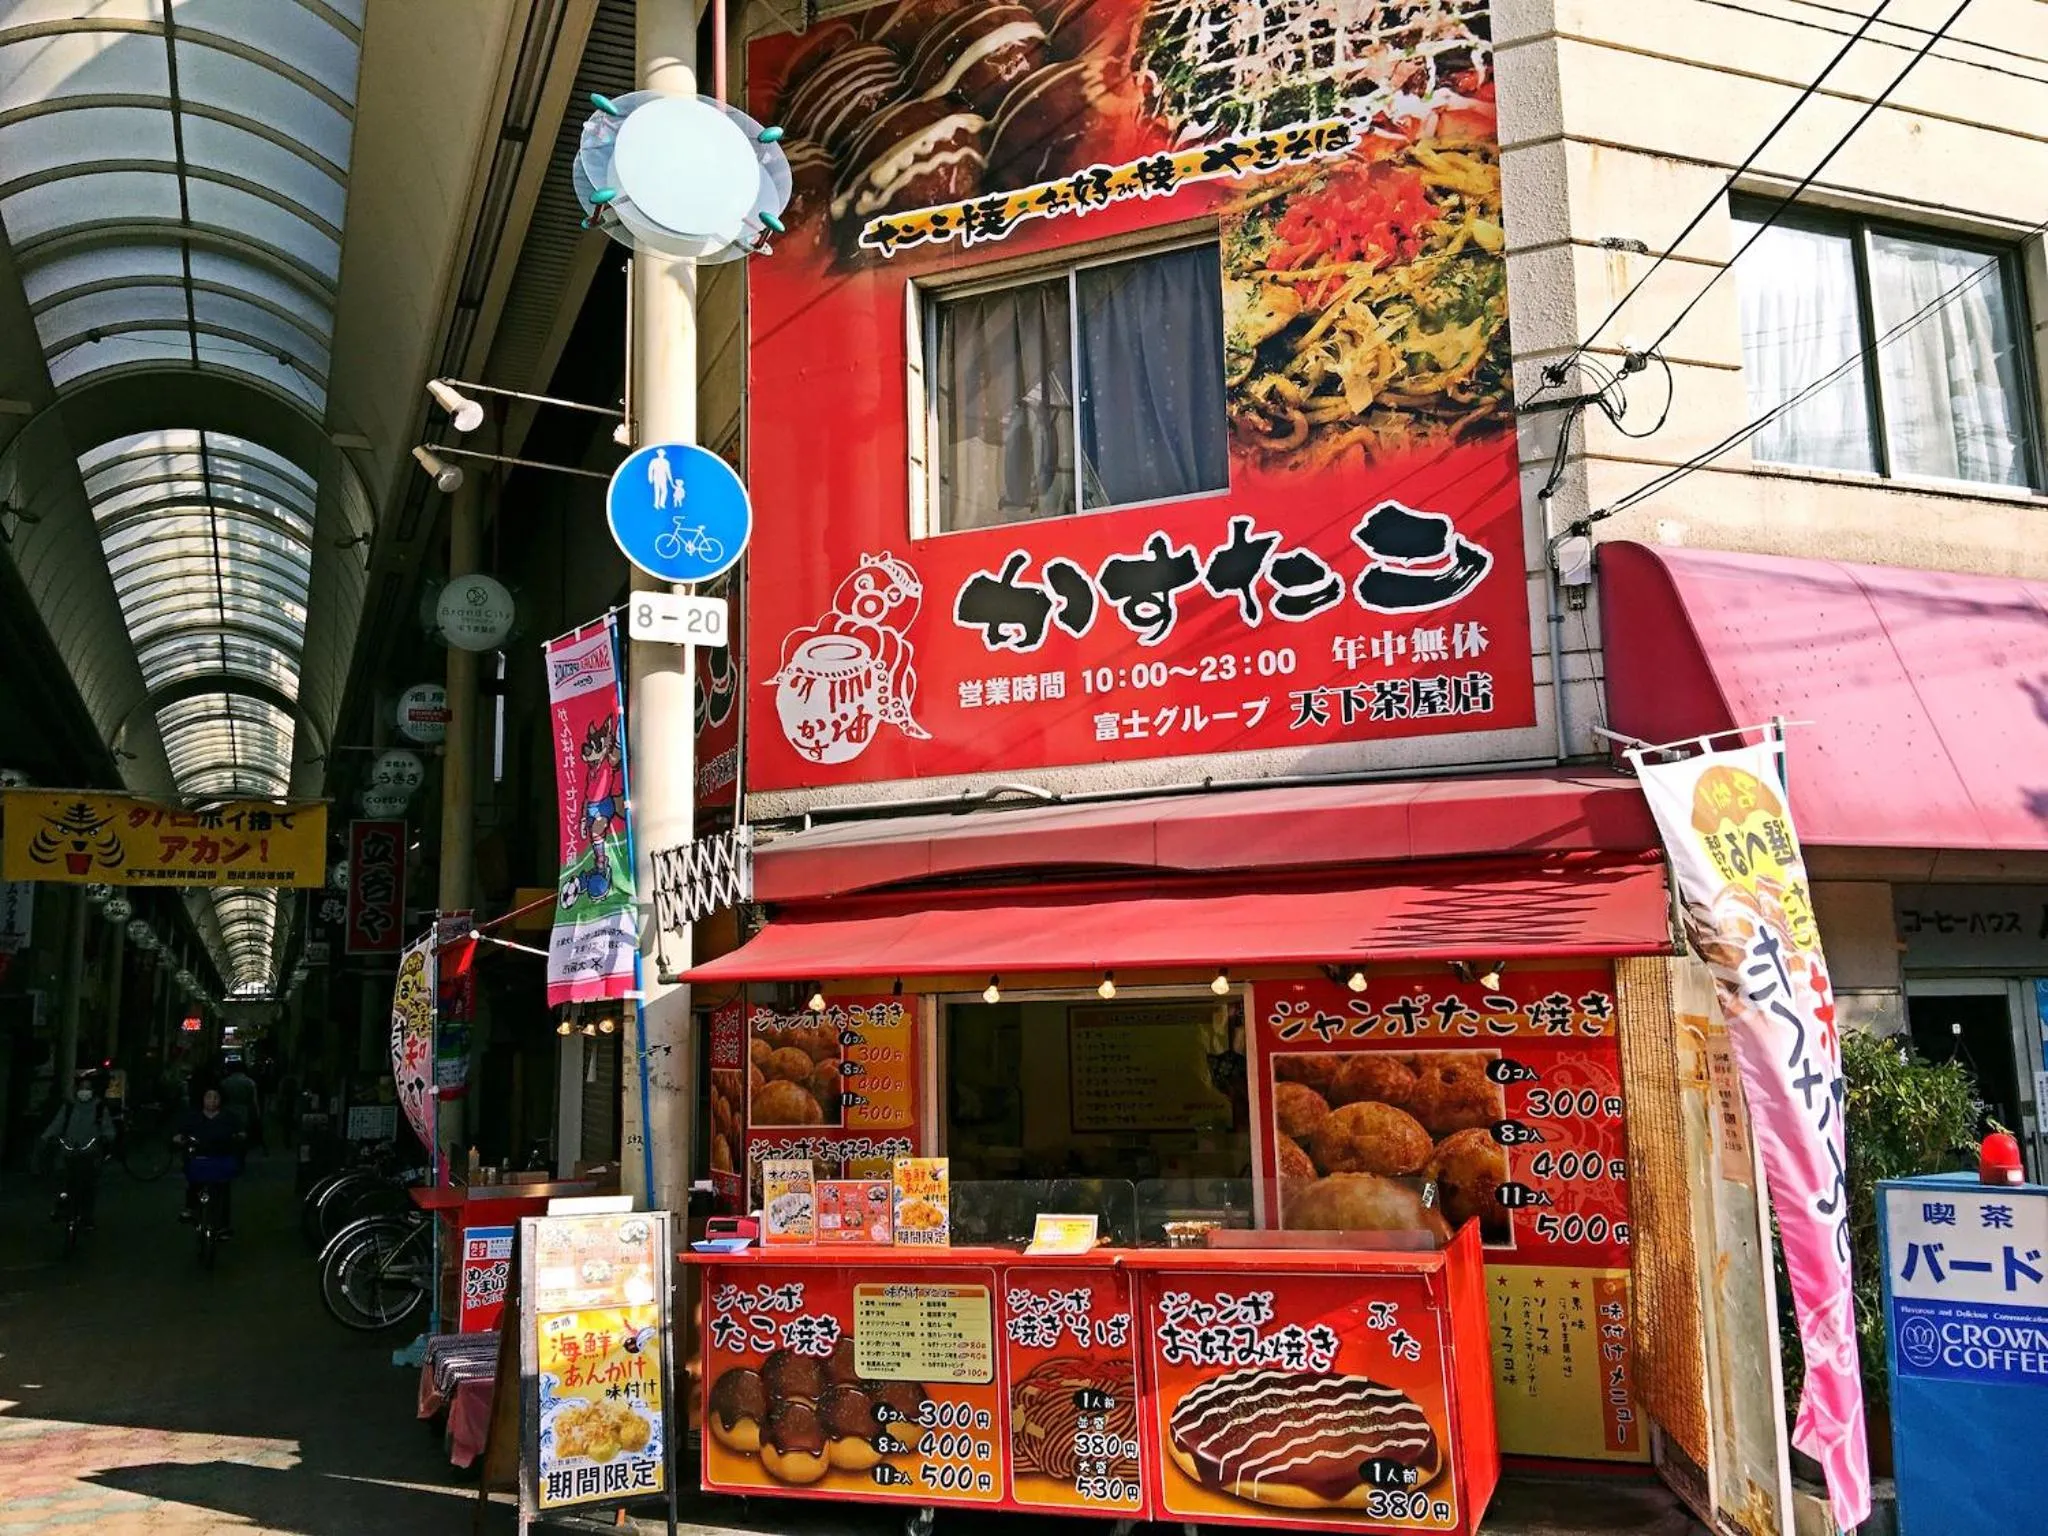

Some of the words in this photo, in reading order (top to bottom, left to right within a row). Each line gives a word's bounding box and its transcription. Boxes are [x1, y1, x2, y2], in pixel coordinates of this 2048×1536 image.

[953, 500, 1494, 655] かすたこ
[1331, 625, 1491, 672] 年中無休
[957, 670, 1066, 710] 営業時間
[1289, 672, 1494, 731] 天下茶屋店
[1093, 696, 1272, 742] 富士グループ
[1901, 909, 2023, 933] コーヒーハウス
[1496, 1062, 1540, 1081] 6コ入
[1527, 1089, 1623, 1119] 300円
[1501, 1124, 1545, 1144] 8コ入
[1530, 1150, 1627, 1181] 400円
[1500, 1186, 1553, 1207] 11コ入
[1535, 1213, 1631, 1245] 500円
[1900, 1241, 2045, 1292] バード
[712, 1283, 804, 1313] ジャンボ
[1007, 1288, 1092, 1315] ジャンボ
[1160, 1291, 1274, 1324] ジャンボ
[1938, 1309, 1953, 1317] and
[711, 1312, 841, 1357] たこ焼き
[1007, 1313, 1130, 1348] 焼きそば
[1367, 1301, 1422, 1361] ぶた
[1497, 1295, 1518, 1386] ソースマヨ味
[1533, 1297, 1552, 1356] ソース味
[1941, 1321, 2048, 1352] CROWN
[551, 1331, 613, 1363] 海鮮
[1158, 1324, 1339, 1371] お好み焼き
[1943, 1344, 2048, 1375] COFFEE
[564, 1355, 648, 1388] あんかけ
[1600, 1301, 1634, 1445] 味付けメニュー
[605, 1379, 658, 1401] 味付け
[1082, 1391, 1115, 1410] 1人前
[877, 1405, 908, 1423] 6コ入
[918, 1401, 992, 1430] 300円
[877, 1437, 909, 1454] 8コ入
[918, 1431, 992, 1459] 400円
[1074, 1434, 1139, 1459] 380円
[546, 1459, 657, 1502] 期間限定
[874, 1466, 913, 1485] 11コ入
[920, 1463, 993, 1491] 500円
[1077, 1460, 1108, 1476] 大盛
[1372, 1462, 1418, 1484] 1人前
[1076, 1477, 1140, 1501] 530円
[1366, 1491, 1451, 1521] 380円
